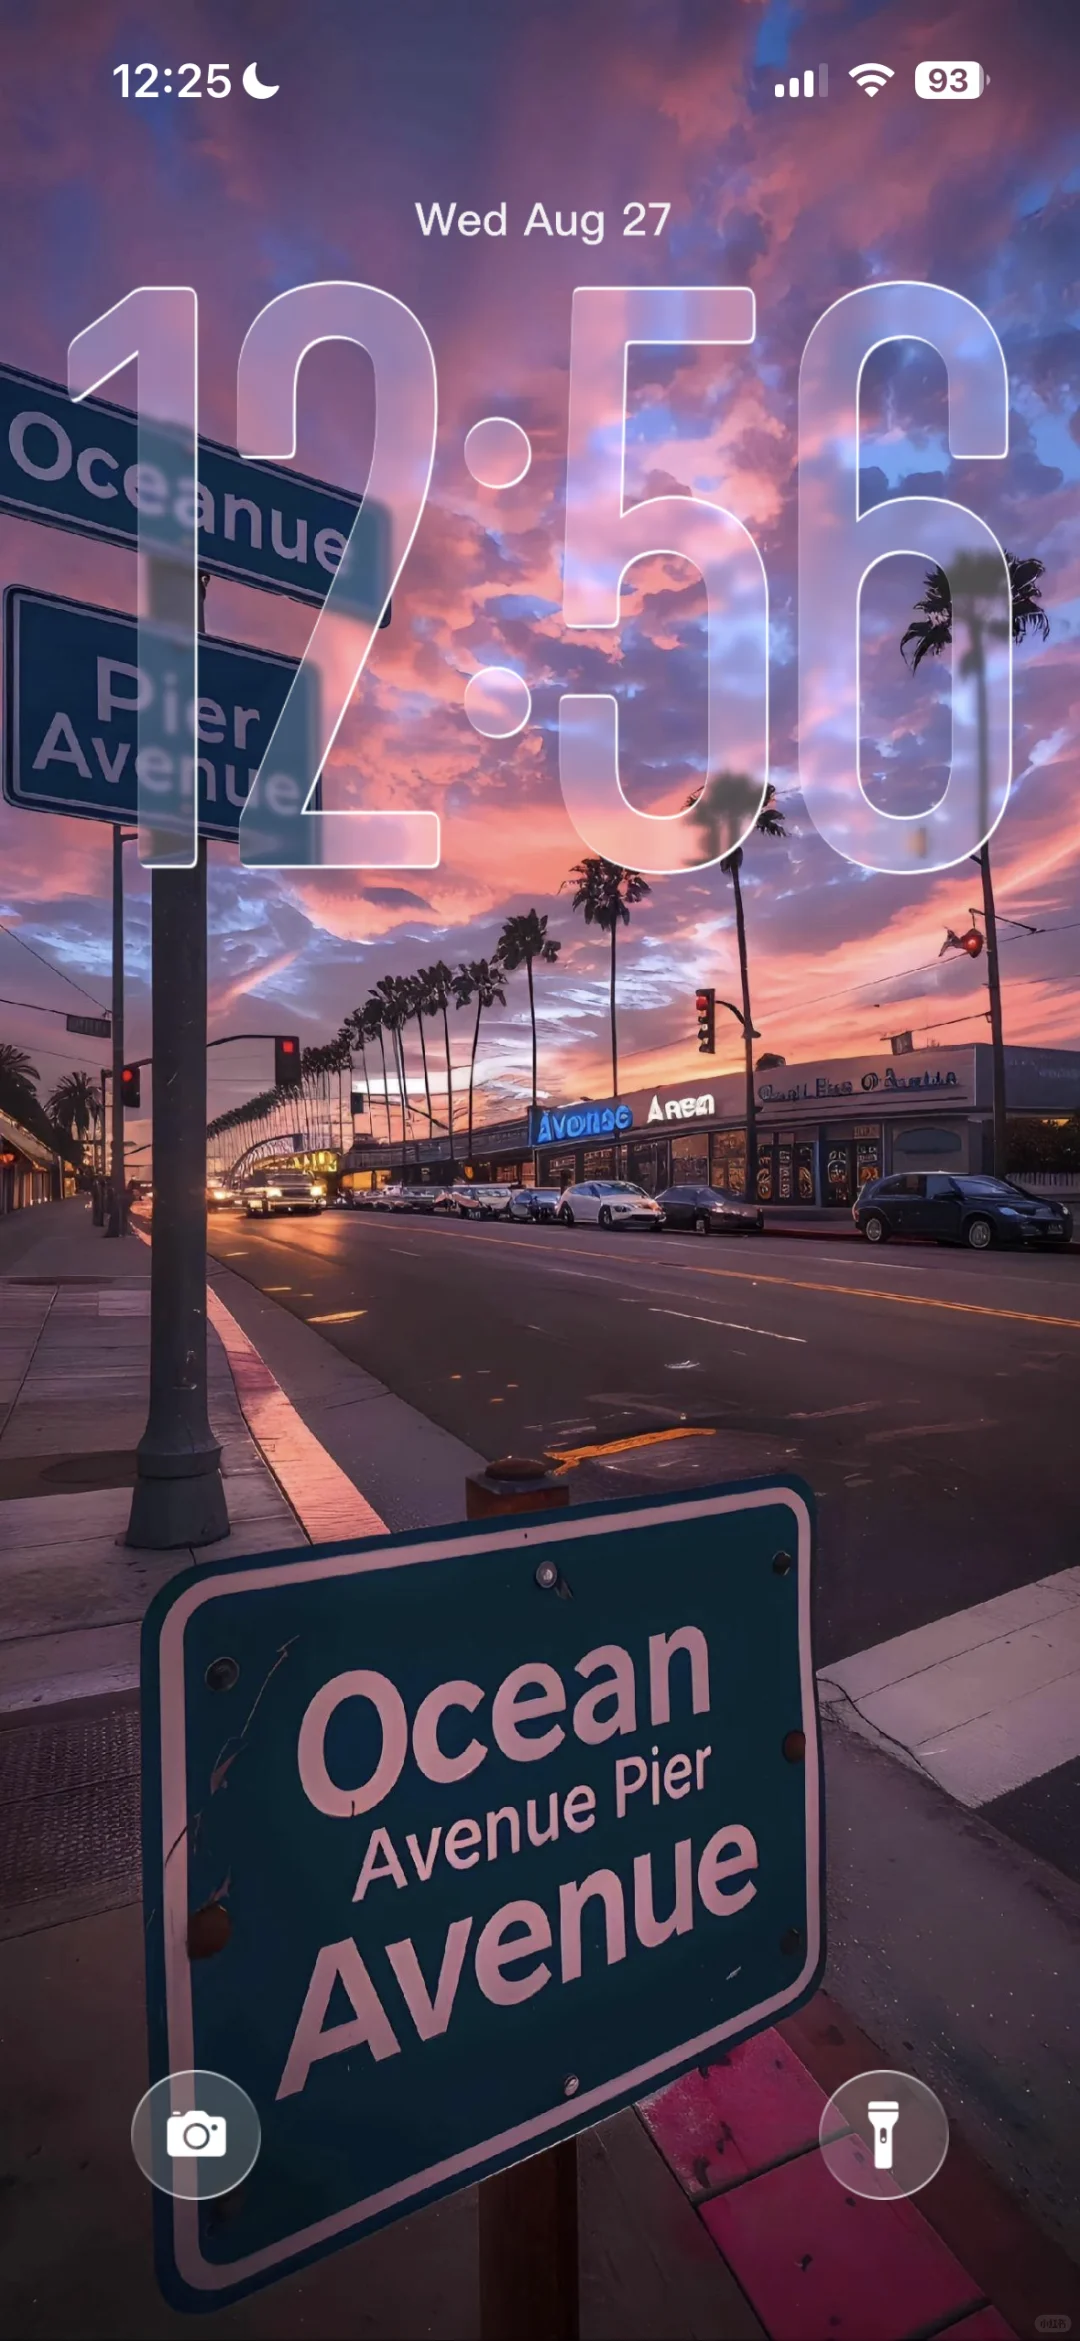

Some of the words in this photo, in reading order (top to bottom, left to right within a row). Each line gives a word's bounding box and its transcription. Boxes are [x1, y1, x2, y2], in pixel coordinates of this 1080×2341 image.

[8, 411, 353, 576] Oceanue
[32, 711, 301, 816] Avenue
[96, 655, 261, 751] Pier
[297, 1624, 711, 1818] Ocean
[351, 1779, 597, 1903] Avenue
[614, 1745, 713, 1819] Pier
[274, 1823, 760, 2101] Avenue
